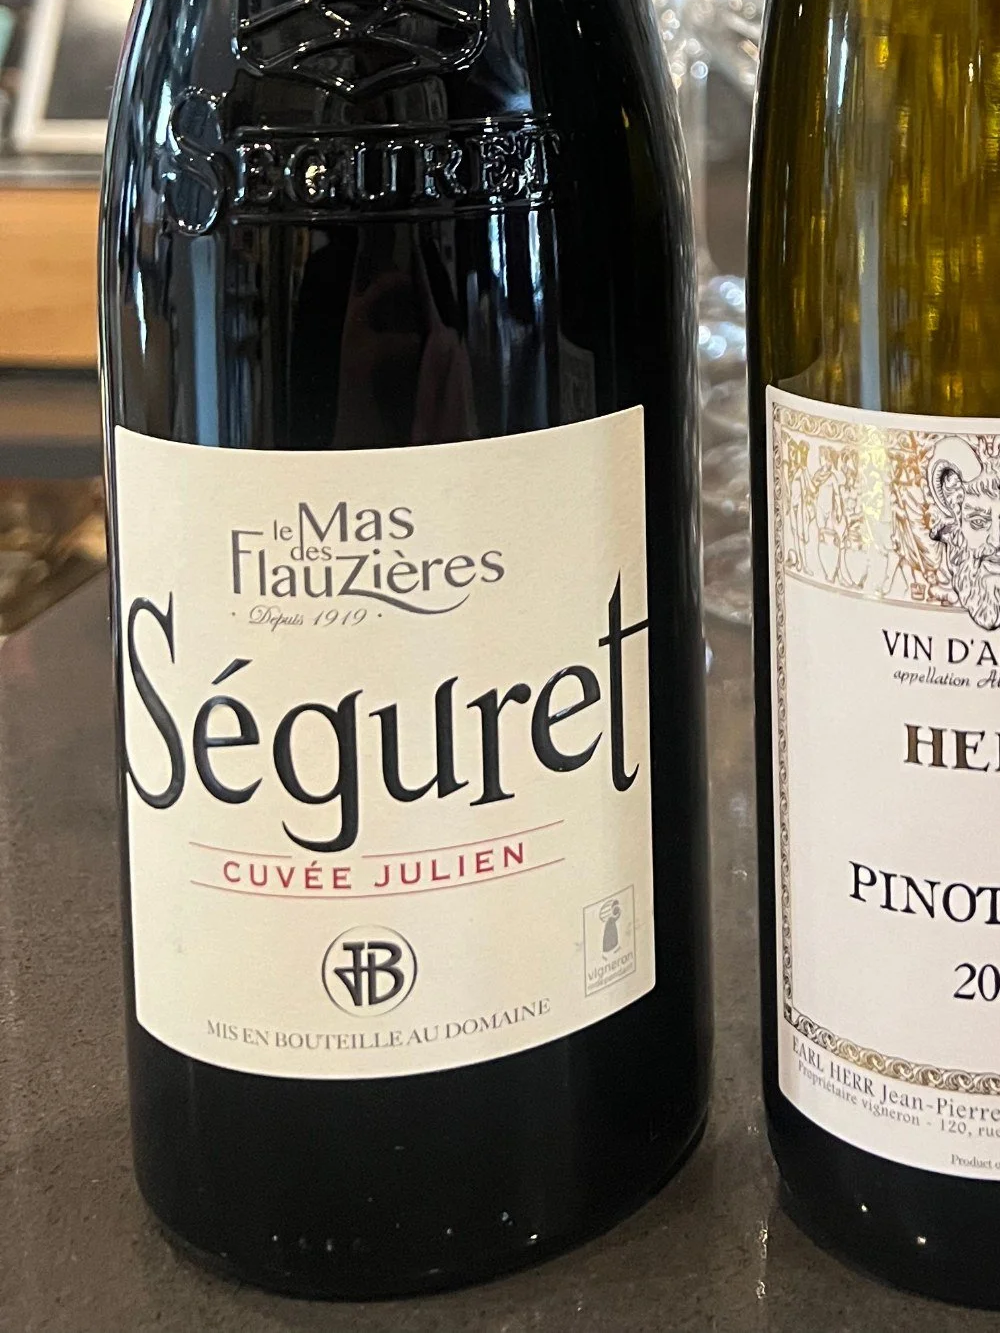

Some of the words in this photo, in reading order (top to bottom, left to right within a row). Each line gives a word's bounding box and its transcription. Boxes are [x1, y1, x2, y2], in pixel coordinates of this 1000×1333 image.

[273, 519, 294, 541] le
[298, 501, 415, 543] Mas
[290, 544, 332, 561] des
[312, 608, 367, 627] 1919
[882, 629, 933, 661] VIN
[893, 667, 970, 688] appellation
[127, 568, 649, 852] Séguret
[223, 860, 351, 889] CUVÉE
[374, 842, 524, 887] JULIEN
[207, 1019, 238, 1041] MIS
[243, 1027, 271, 1046] EN
[275, 1031, 403, 1051] BOUTEILLE
[407, 1025, 439, 1046] AU
[445, 997, 551, 1039] DOMAINE
[793, 1035, 824, 1073] EARL
[830, 1061, 875, 1097] HERR
[861, 1099, 920, 1127] vigneron
[940, 1118, 972, 1138] 120,
[951, 1153, 992, 1168] Product
